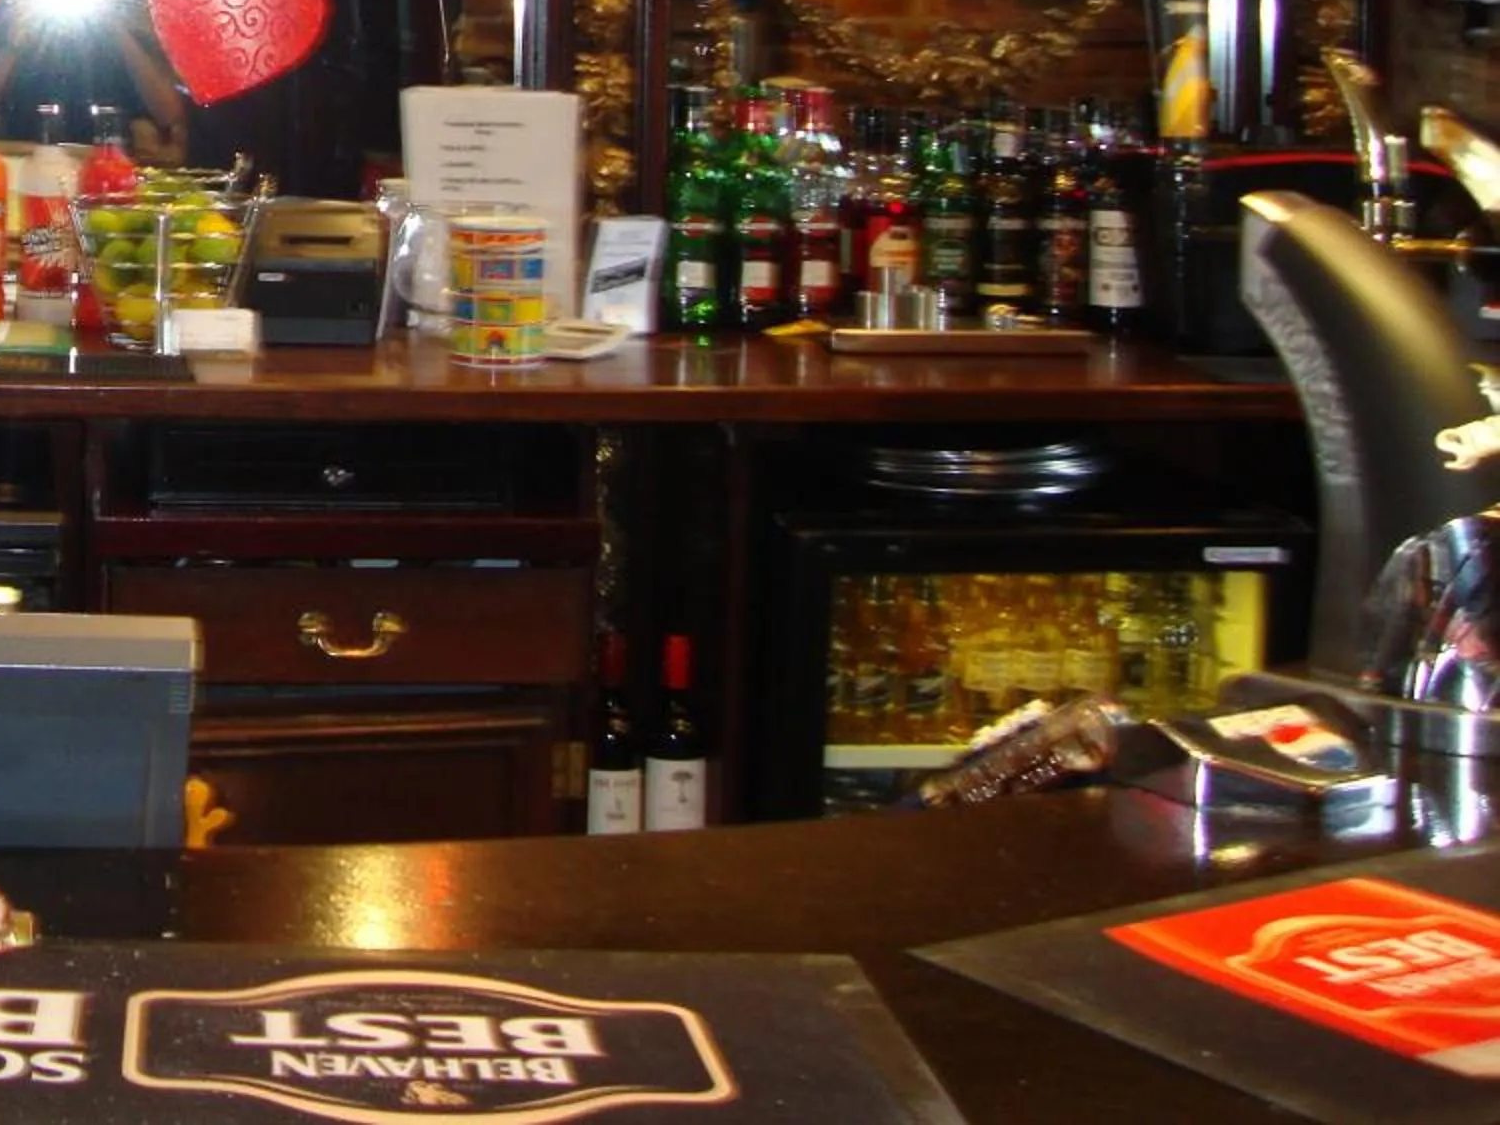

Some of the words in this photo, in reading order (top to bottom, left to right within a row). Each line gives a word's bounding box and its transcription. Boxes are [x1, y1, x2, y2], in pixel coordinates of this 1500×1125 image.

[1293, 929, 1492, 985] BEST
[231, 1009, 607, 1058] BEST
[270, 1049, 579, 1086] BELHAVEN
